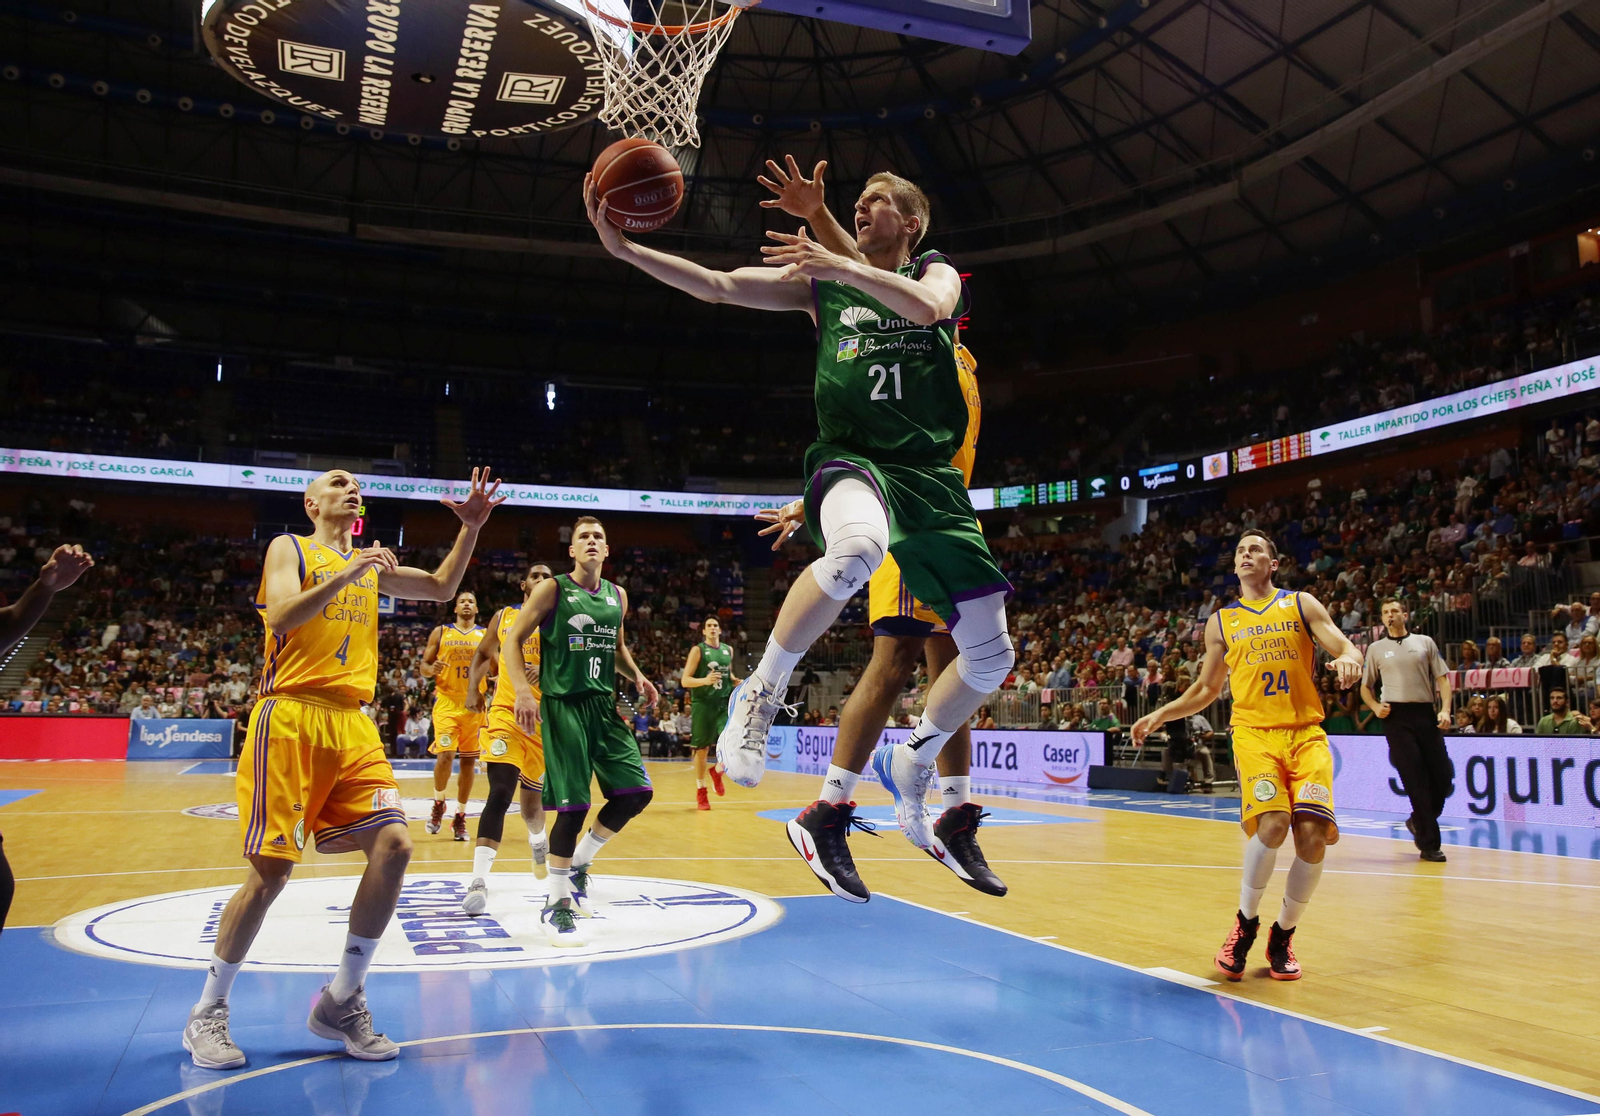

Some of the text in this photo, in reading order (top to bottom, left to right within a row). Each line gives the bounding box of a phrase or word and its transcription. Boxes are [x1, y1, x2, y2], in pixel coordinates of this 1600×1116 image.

[363, 55, 395, 75] LA
[441, 4, 501, 135] GRUPO LA RESERVA
[358, 76, 392, 126] RESERVA
[471, 111, 579, 138] PORTICO
[877, 317, 932, 330] Unic
[868, 363, 903, 401] 21
[1338, 365, 1596, 441] TALLER IMPARTIDO POR LOS CHEFS PEÑA Y JOSÉ
[20, 456, 52, 468] PEÑA
[56, 460, 64, 468] Y
[67, 461, 95, 471] JOSÉ
[99, 463, 146, 475] CARLOS
[150, 466, 195, 478] GARCÍA
[1186, 464, 1195, 479] 0
[265, 474, 304, 485] TALLER
[370, 482, 392, 491] POR
[395, 484, 414, 493] LOS
[418, 485, 450, 495] CHEFS
[1121, 477, 1130, 490] 0
[520, 491, 559, 501] CARLOS
[562, 492, 600, 503] GARCÍA
[660, 498, 694, 508] TALLER
[697, 500, 750, 509] IMPARTIDO
[753, 501, 773, 510] POR
[593, 625, 617, 637] Unicaj
[1231, 621, 1300, 643] HERBALIFE
[335, 634, 350, 666] 4
[1250, 637, 1287, 650] Gran
[1246, 648, 1300, 665] Canaria
[456, 666, 470, 679] 13
[589, 656, 602, 679] 16
[1262, 669, 1290, 697] 24
[796, 729, 835, 762] Segur
[970, 741, 1019, 770] nza
[1043, 744, 1080, 763] Caser
